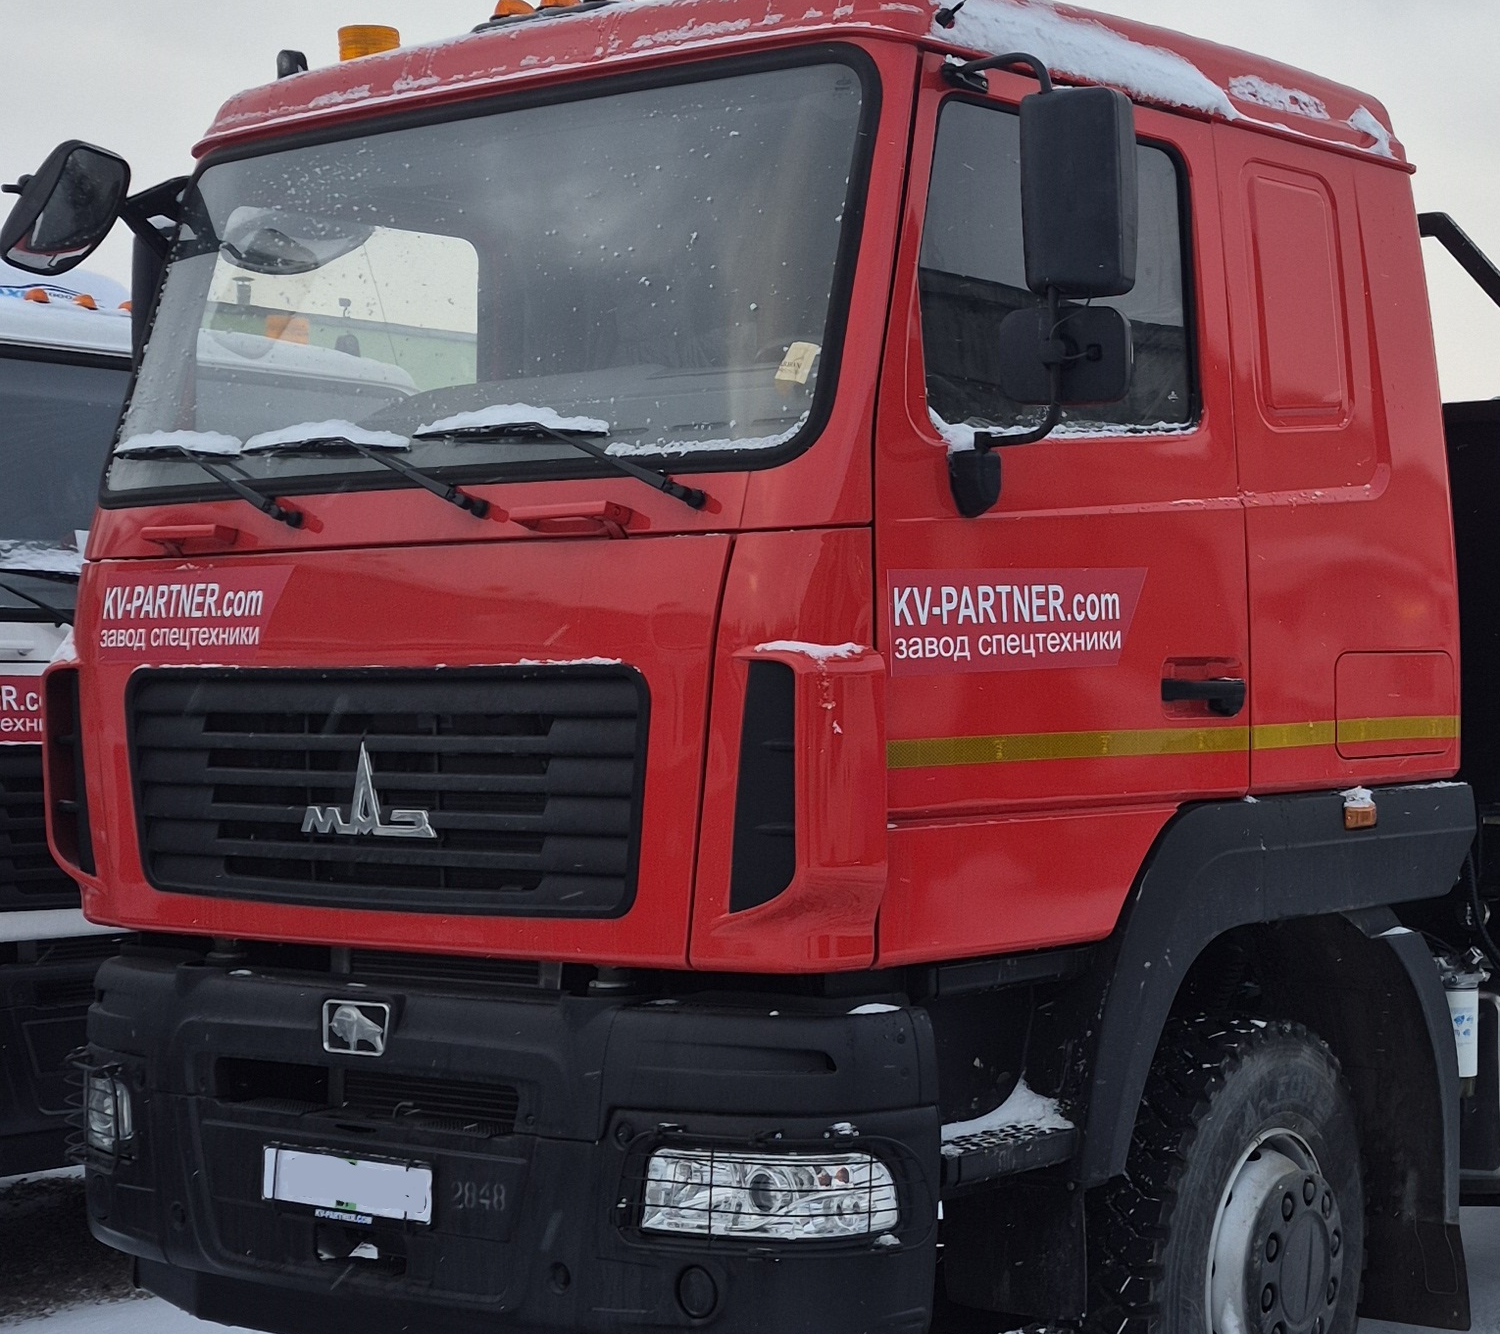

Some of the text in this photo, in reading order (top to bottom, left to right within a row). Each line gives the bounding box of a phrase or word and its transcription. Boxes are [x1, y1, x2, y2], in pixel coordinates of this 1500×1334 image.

[102, 583, 264, 620] KV-PARTNER.com
[893, 584, 1120, 626] KV-PARTNER.com
[100, 626, 260, 651] завод спецтехники
[894, 630, 1122, 661] завод спецтехники
[0, 685, 42, 711] R.c
[452, 1181, 506, 1211] 2848
